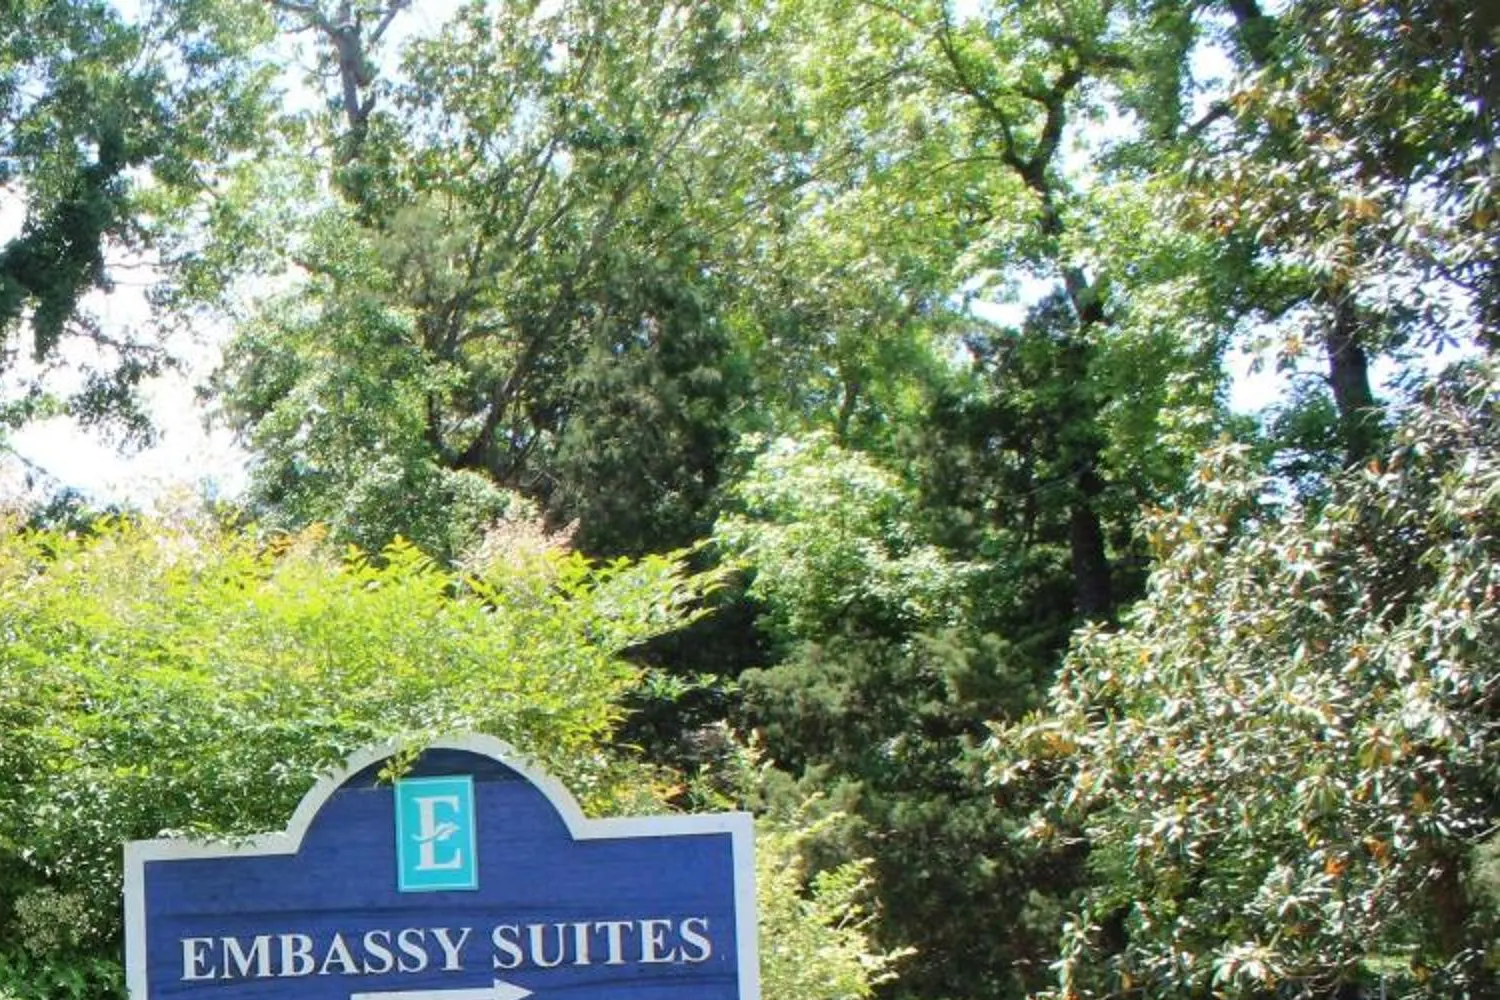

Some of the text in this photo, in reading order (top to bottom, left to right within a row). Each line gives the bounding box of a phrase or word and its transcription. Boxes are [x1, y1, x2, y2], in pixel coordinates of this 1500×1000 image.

[413, 796, 463, 871] E
[180, 917, 712, 981] EMBASSY SUITES
